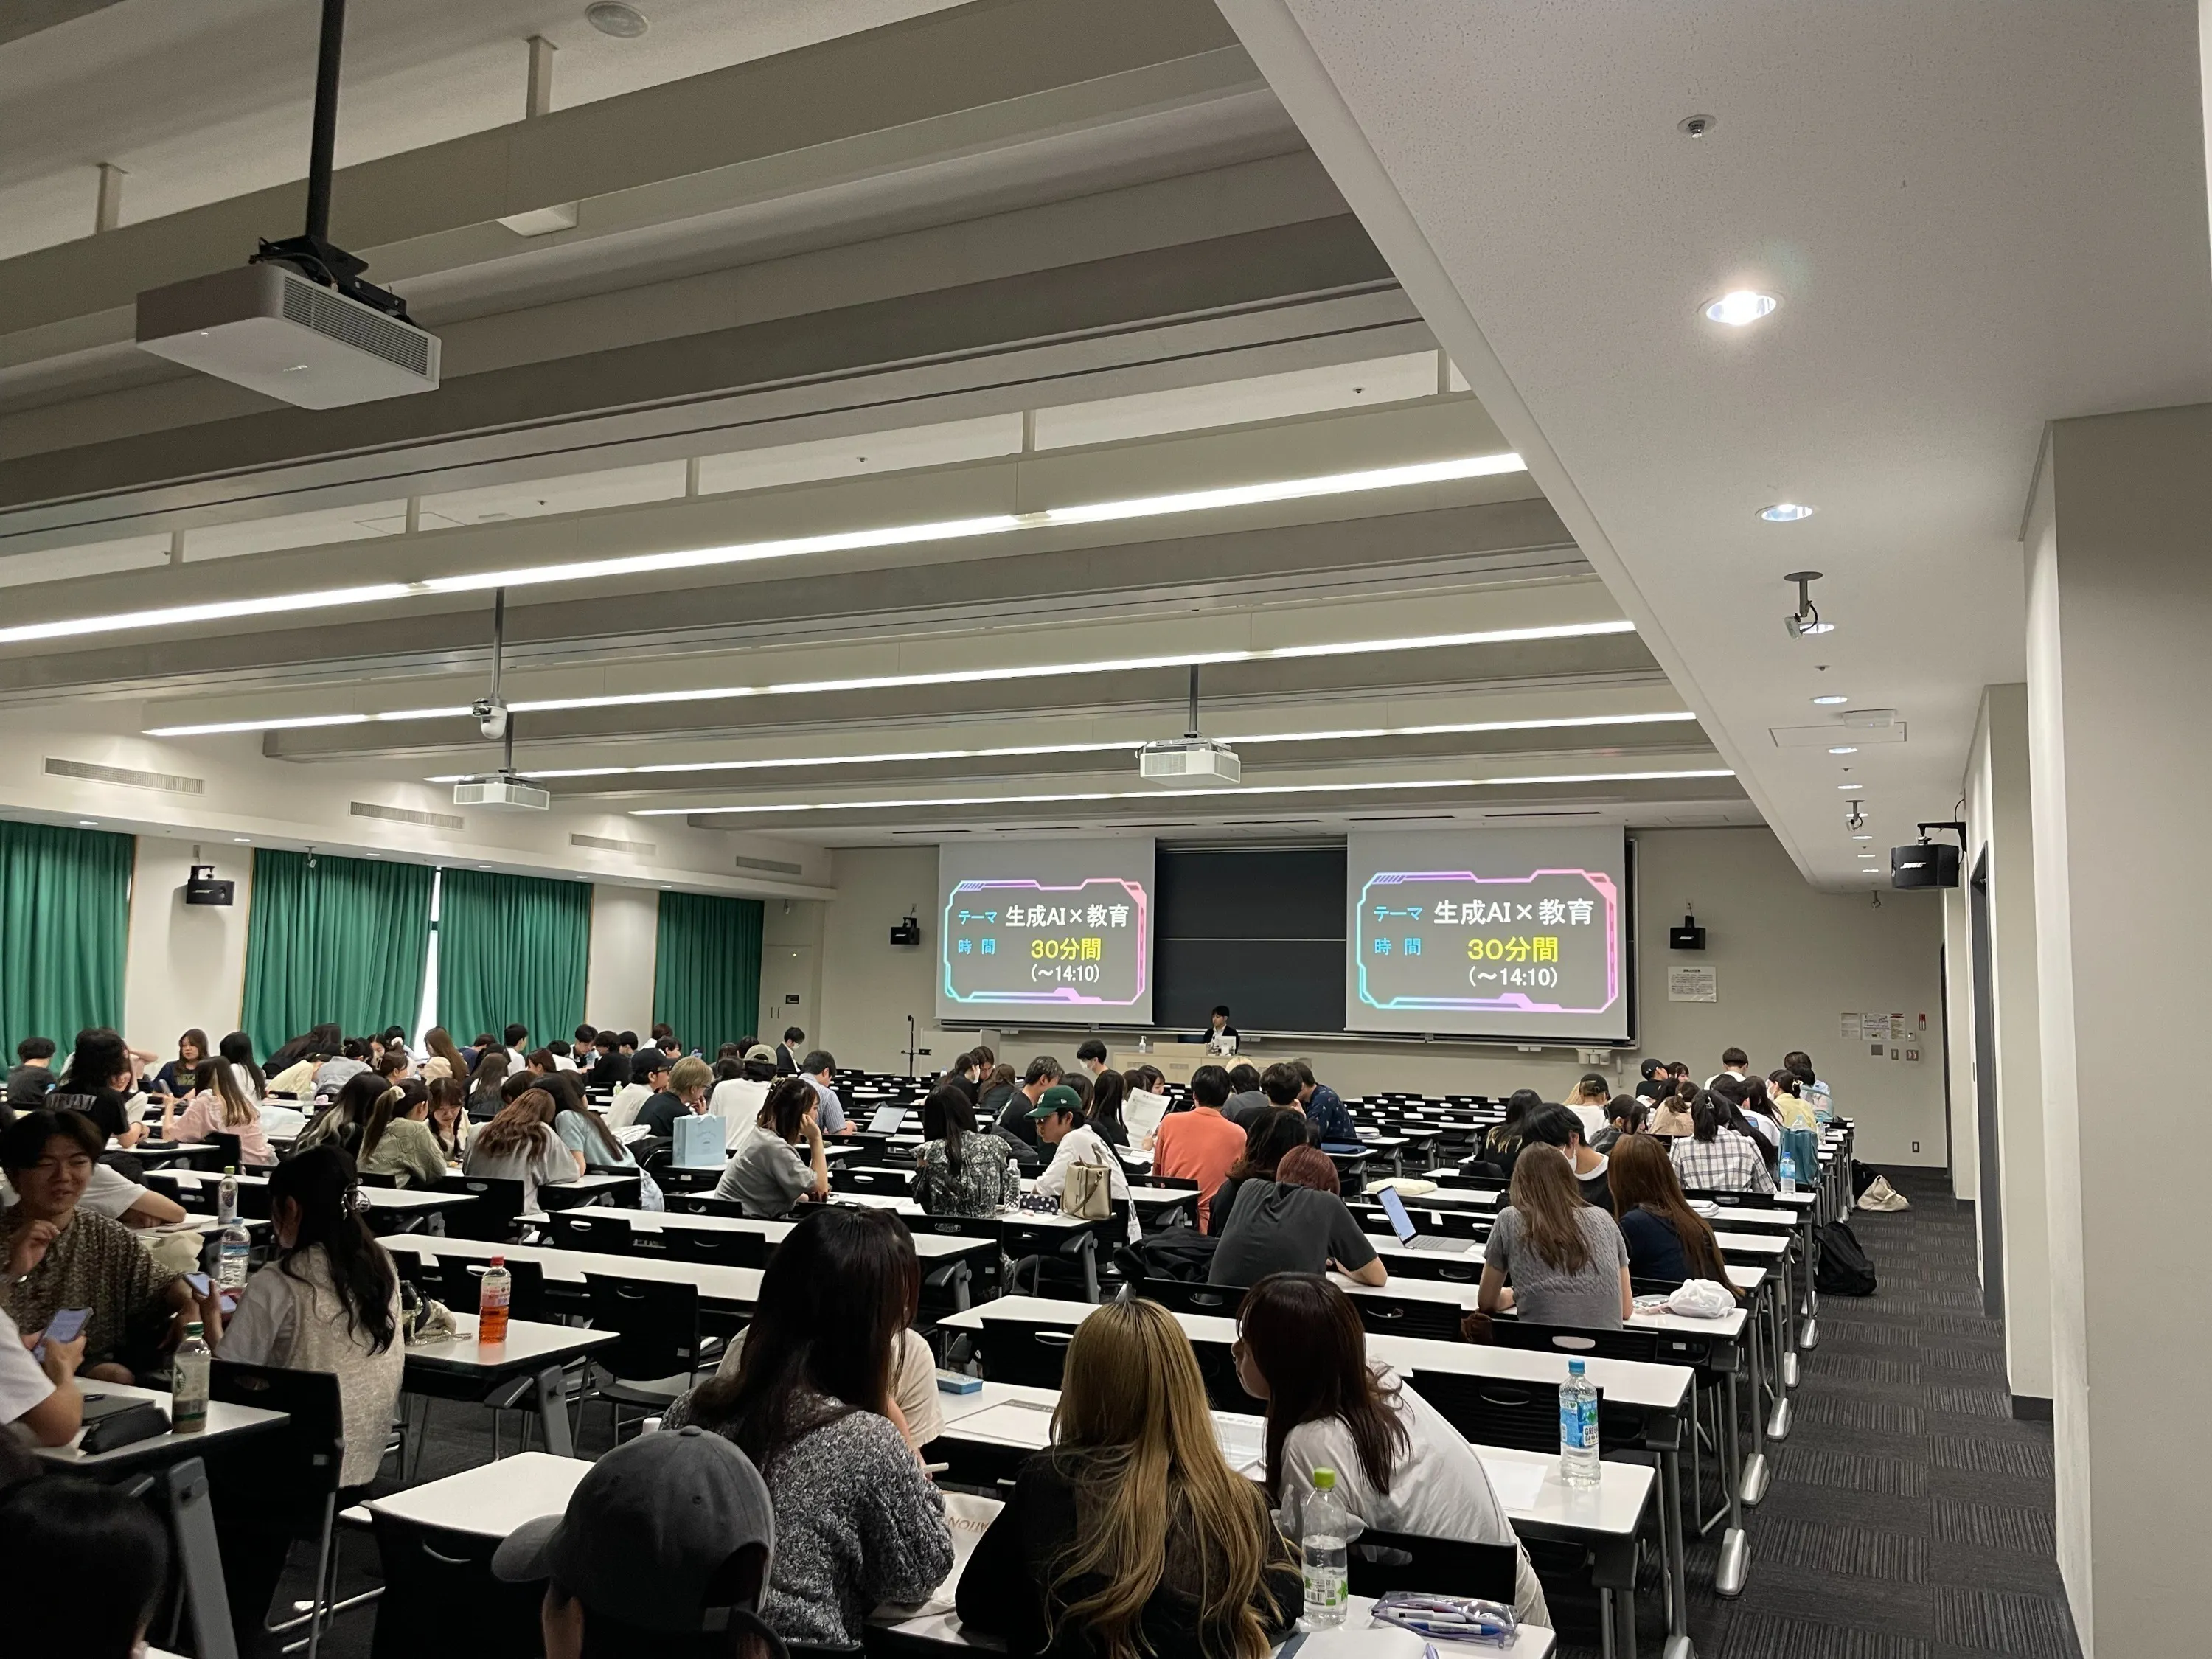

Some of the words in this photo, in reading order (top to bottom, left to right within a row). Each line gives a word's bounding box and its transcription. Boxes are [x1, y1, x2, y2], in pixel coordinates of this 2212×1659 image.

[958, 910, 998, 925] テーマ
[1005, 904, 1130, 928] 生成AI×教育
[1374, 905, 1423, 922] テーマ
[1433, 898, 1594, 925] 生成AI×教育
[1031, 937, 1102, 961] 30分間
[1467, 936, 1559, 963] 30分間
